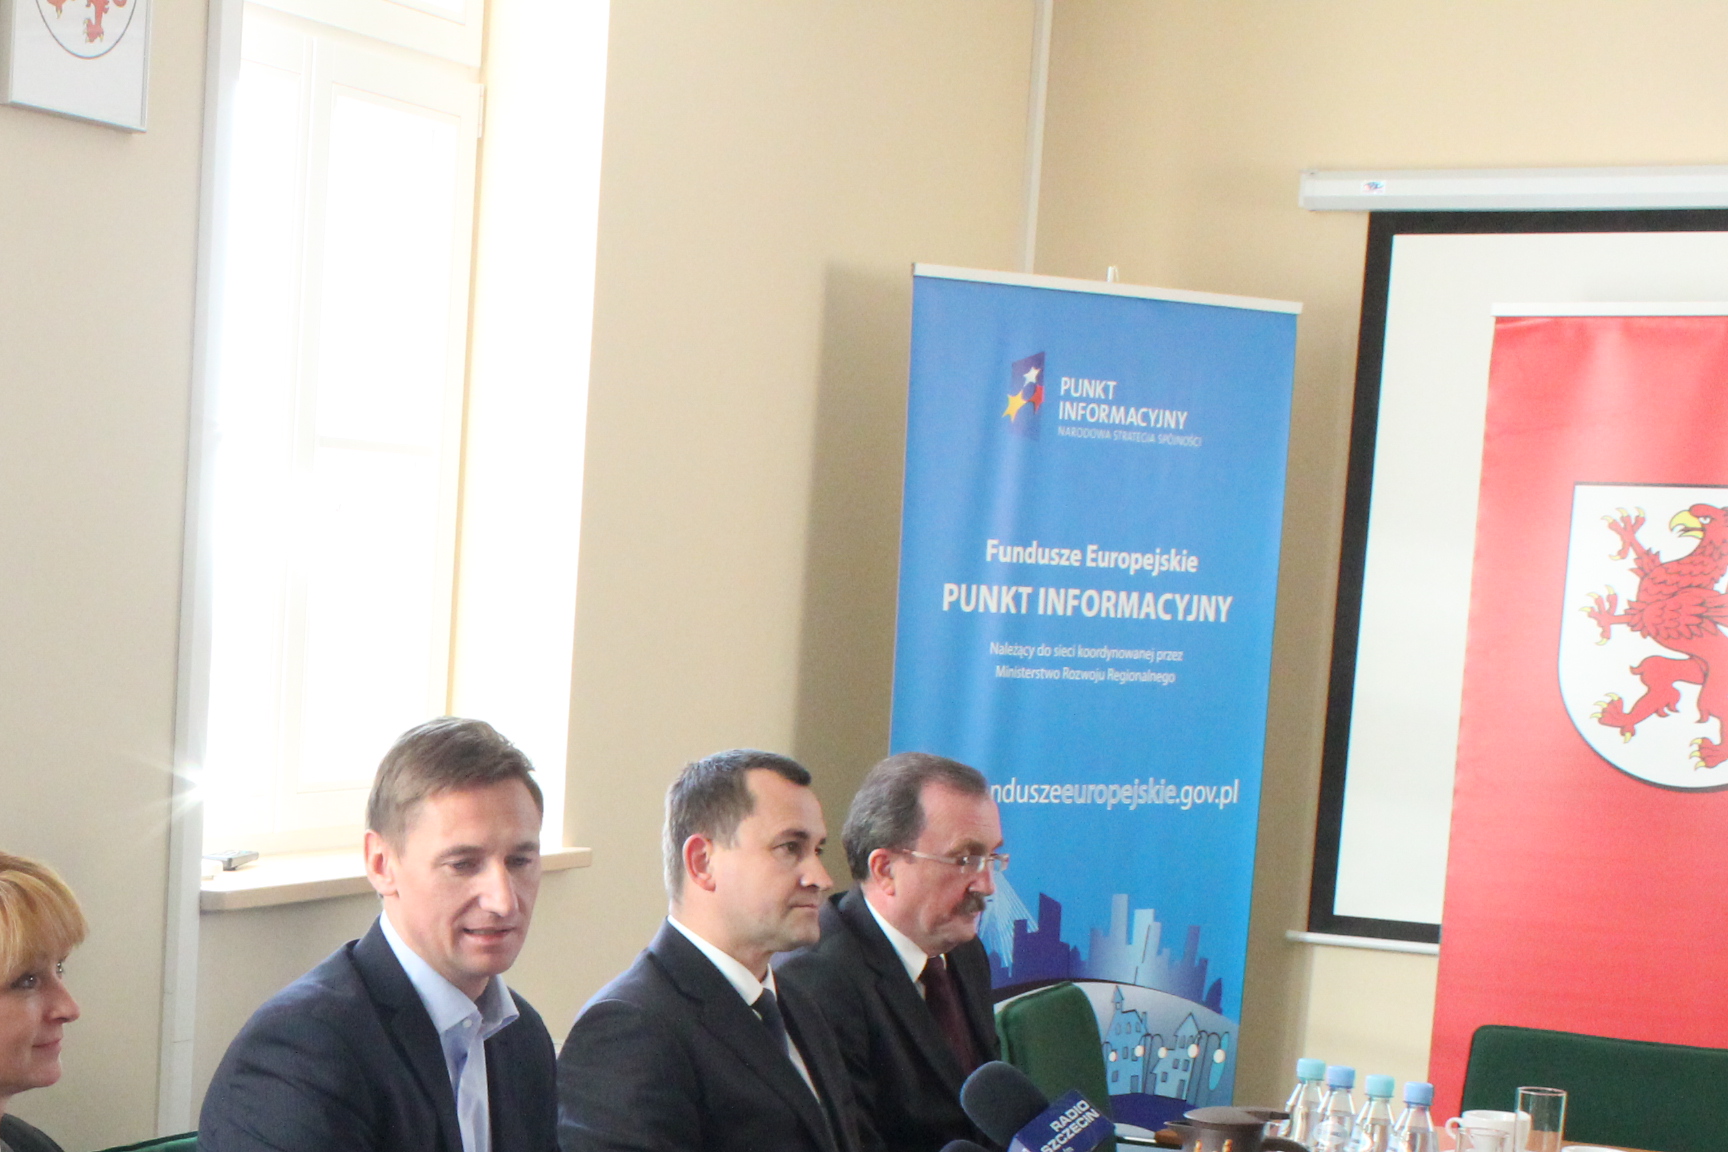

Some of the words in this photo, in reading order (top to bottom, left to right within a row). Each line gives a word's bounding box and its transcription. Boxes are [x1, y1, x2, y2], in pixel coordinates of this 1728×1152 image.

[1060, 376, 1119, 400] PUNKT
[1058, 401, 1189, 430] INFORMACYJNY
[1057, 426, 1112, 439] NARODOWA
[985, 538, 1083, 567] Fundusze
[1085, 544, 1200, 577] Europejskie
[942, 582, 1033, 615] PUNKT
[1037, 587, 1234, 623] INFORMACYJNY
[989, 641, 1036, 659] Należący
[1037, 643, 1052, 657] do
[1053, 644, 1076, 658] sieci
[1077, 645, 1155, 663] koordynowanej
[1156, 650, 1184, 663] przez
[995, 665, 1061, 681] Ministerstwo
[1062, 667, 1106, 684] Rozwoju
[1107, 669, 1177, 686] Regionalnego
[1050, 1099, 1090, 1132] RADIO
